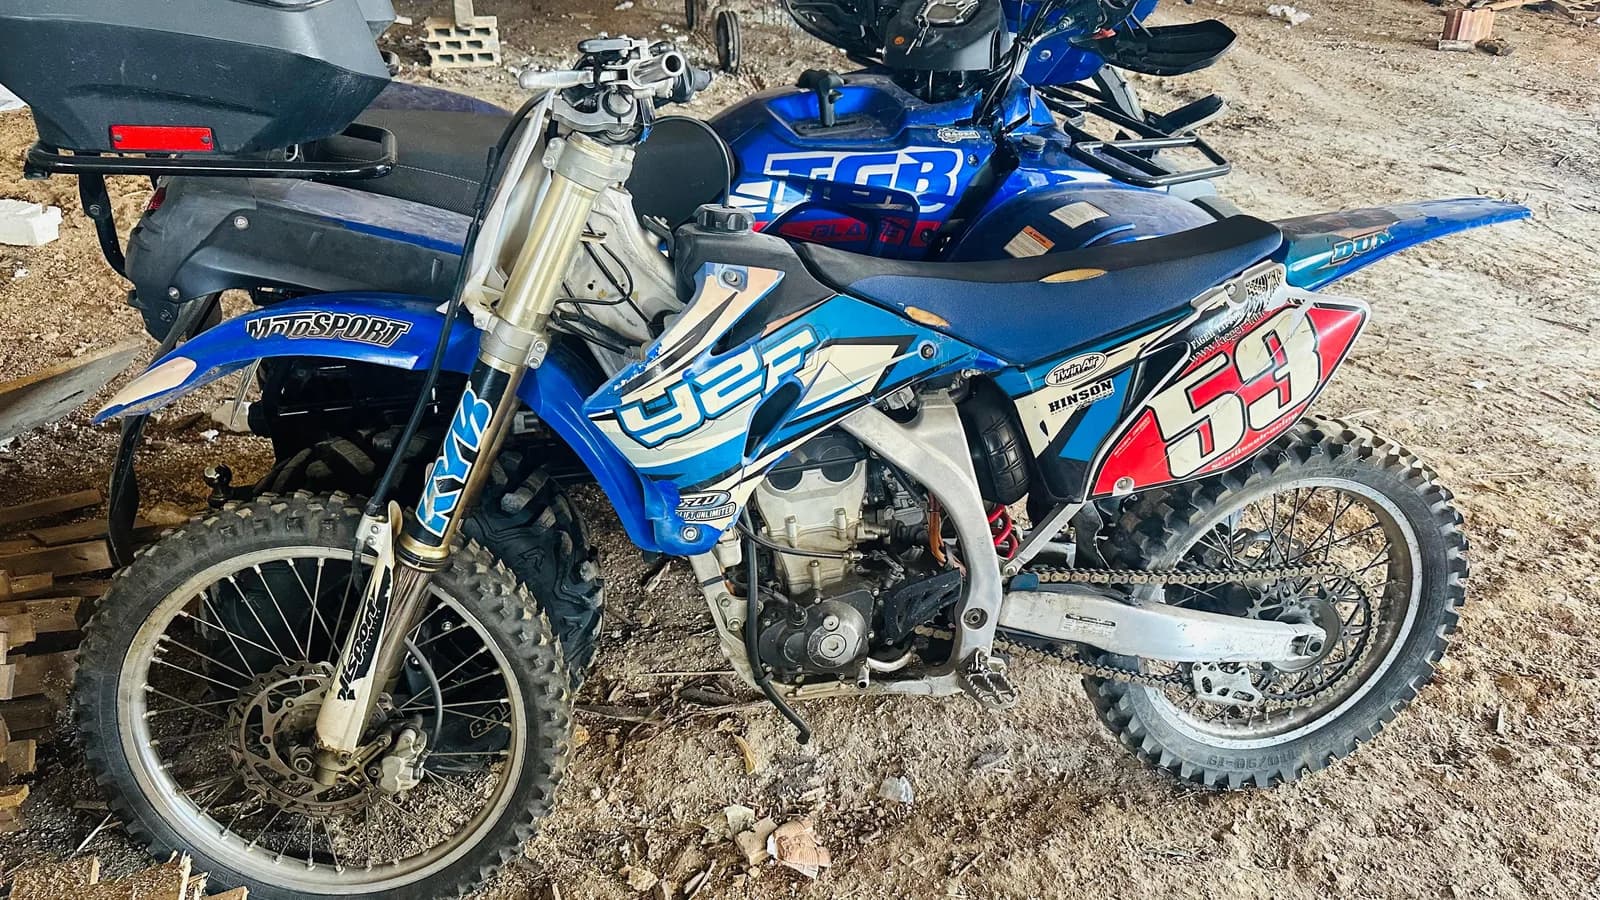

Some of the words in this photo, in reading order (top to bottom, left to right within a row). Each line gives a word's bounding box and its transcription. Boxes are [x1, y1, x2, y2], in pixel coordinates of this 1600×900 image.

[1048, 379, 1113, 413] HINSON
[1053, 363, 1082, 384] Twin
[1081, 355, 1100, 371] Air
[1149, 304, 1322, 478] 53
[415, 388, 493, 538] KYB
